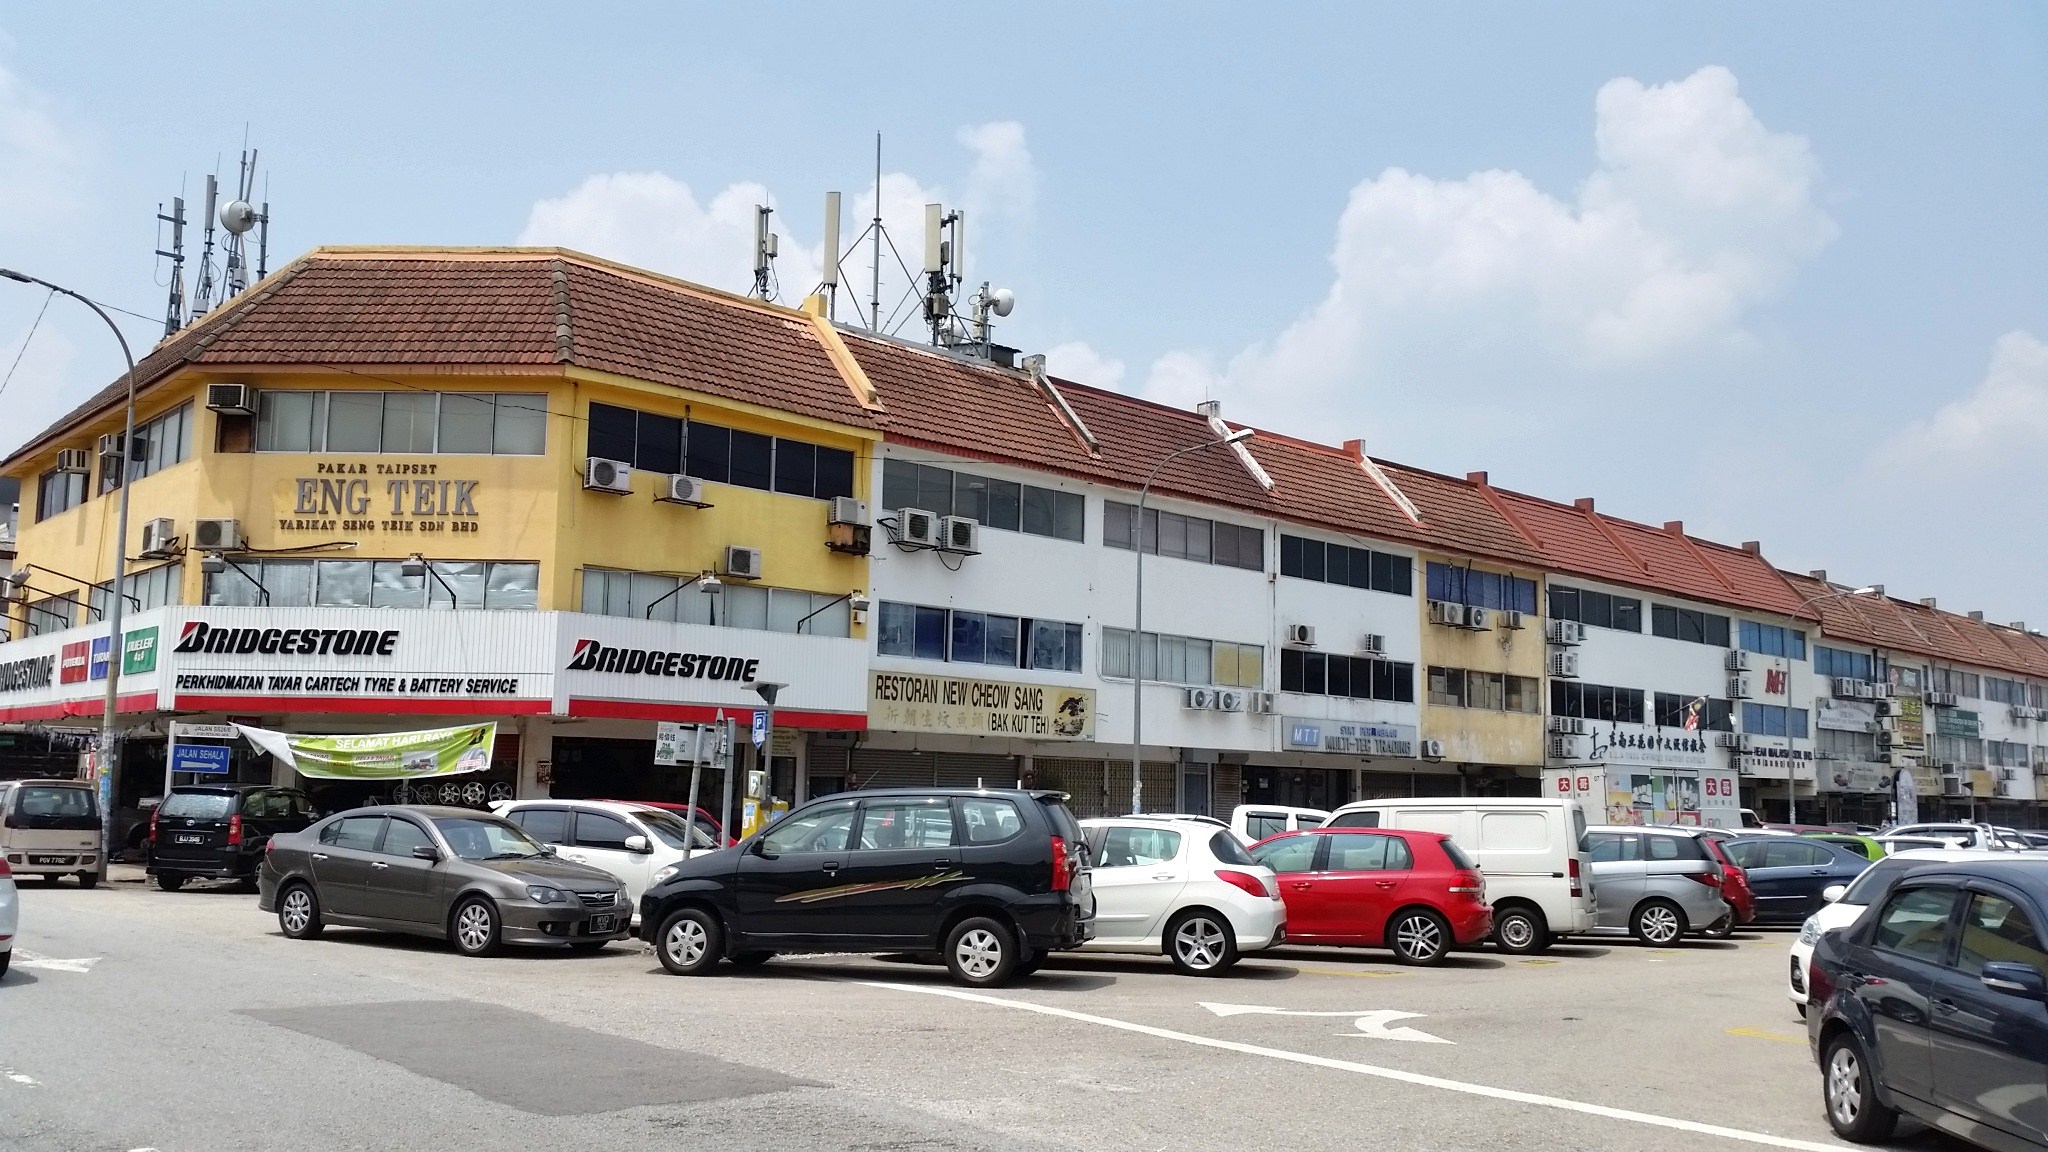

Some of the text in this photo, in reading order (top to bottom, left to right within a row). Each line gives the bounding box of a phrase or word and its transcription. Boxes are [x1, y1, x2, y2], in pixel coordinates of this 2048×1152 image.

[317, 463, 437, 475] PAKAR TAIPSET
[294, 478, 479, 516] ENG TEIK
[279, 519, 479, 532] YARIKAT SENG TEIK SDN BHD
[173, 621, 399, 655] BRIDGESTONE
[565, 638, 760, 682] BRIDGESTONE
[175, 675, 518, 694] PERKHIDMATAN TAYAR CARTECH TYRE & BATTERY SERVICE
[875, 674, 1043, 711] RESTORAN NEW CHEOW SANG
[987, 712, 1050, 735] (BAK KUT TEH)
[336, 736, 389, 750] SELAMAT
[391, 733, 421, 747] HARI
[423, 731, 455, 742] RAYA
[1374, 740, 1411, 755] TRADING
[176, 749, 224, 760] JALAN SEHALA
[1560, 778, 1589, 792] 大哥
[1706, 778, 1732, 796] 大哥
